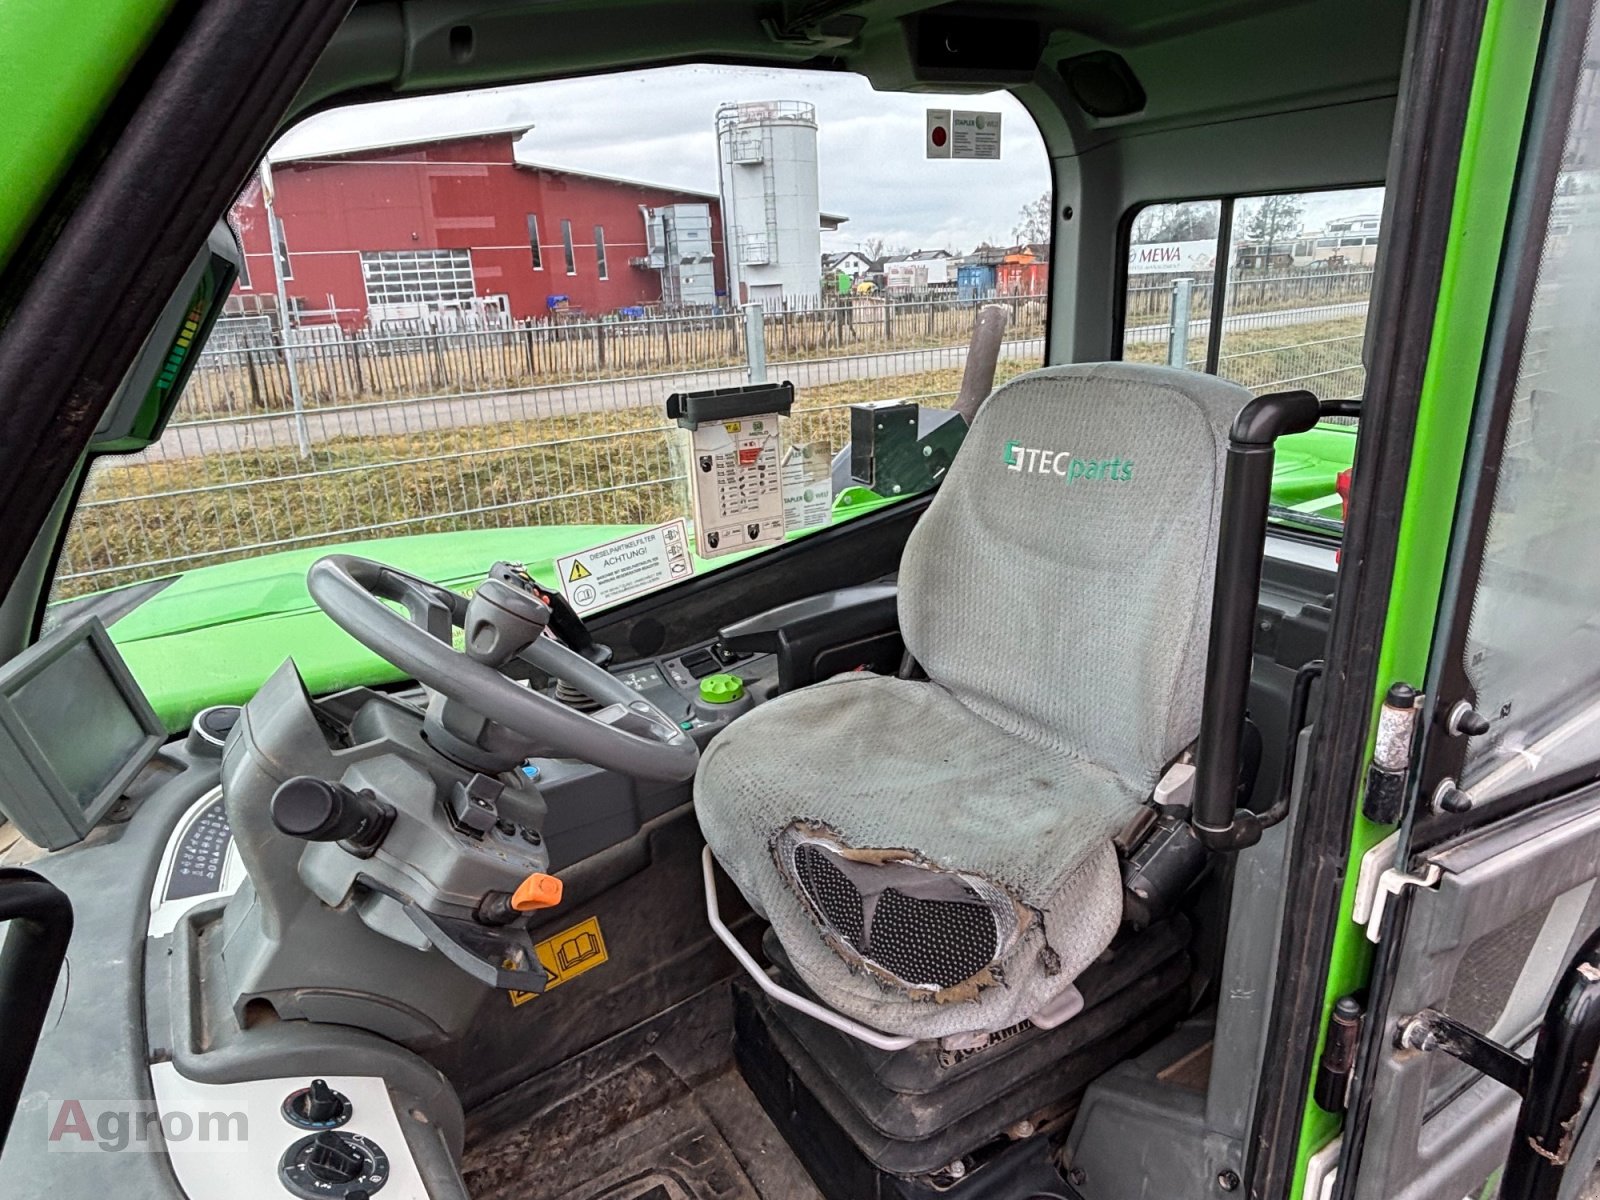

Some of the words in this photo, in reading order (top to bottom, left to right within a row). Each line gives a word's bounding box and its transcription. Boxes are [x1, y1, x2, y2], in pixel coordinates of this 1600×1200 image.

[1139, 246, 1181, 263] MEWA
[589, 534, 656, 561] DIESELPARTIKELFILTER
[603, 547, 648, 568] ACHTUNG!
